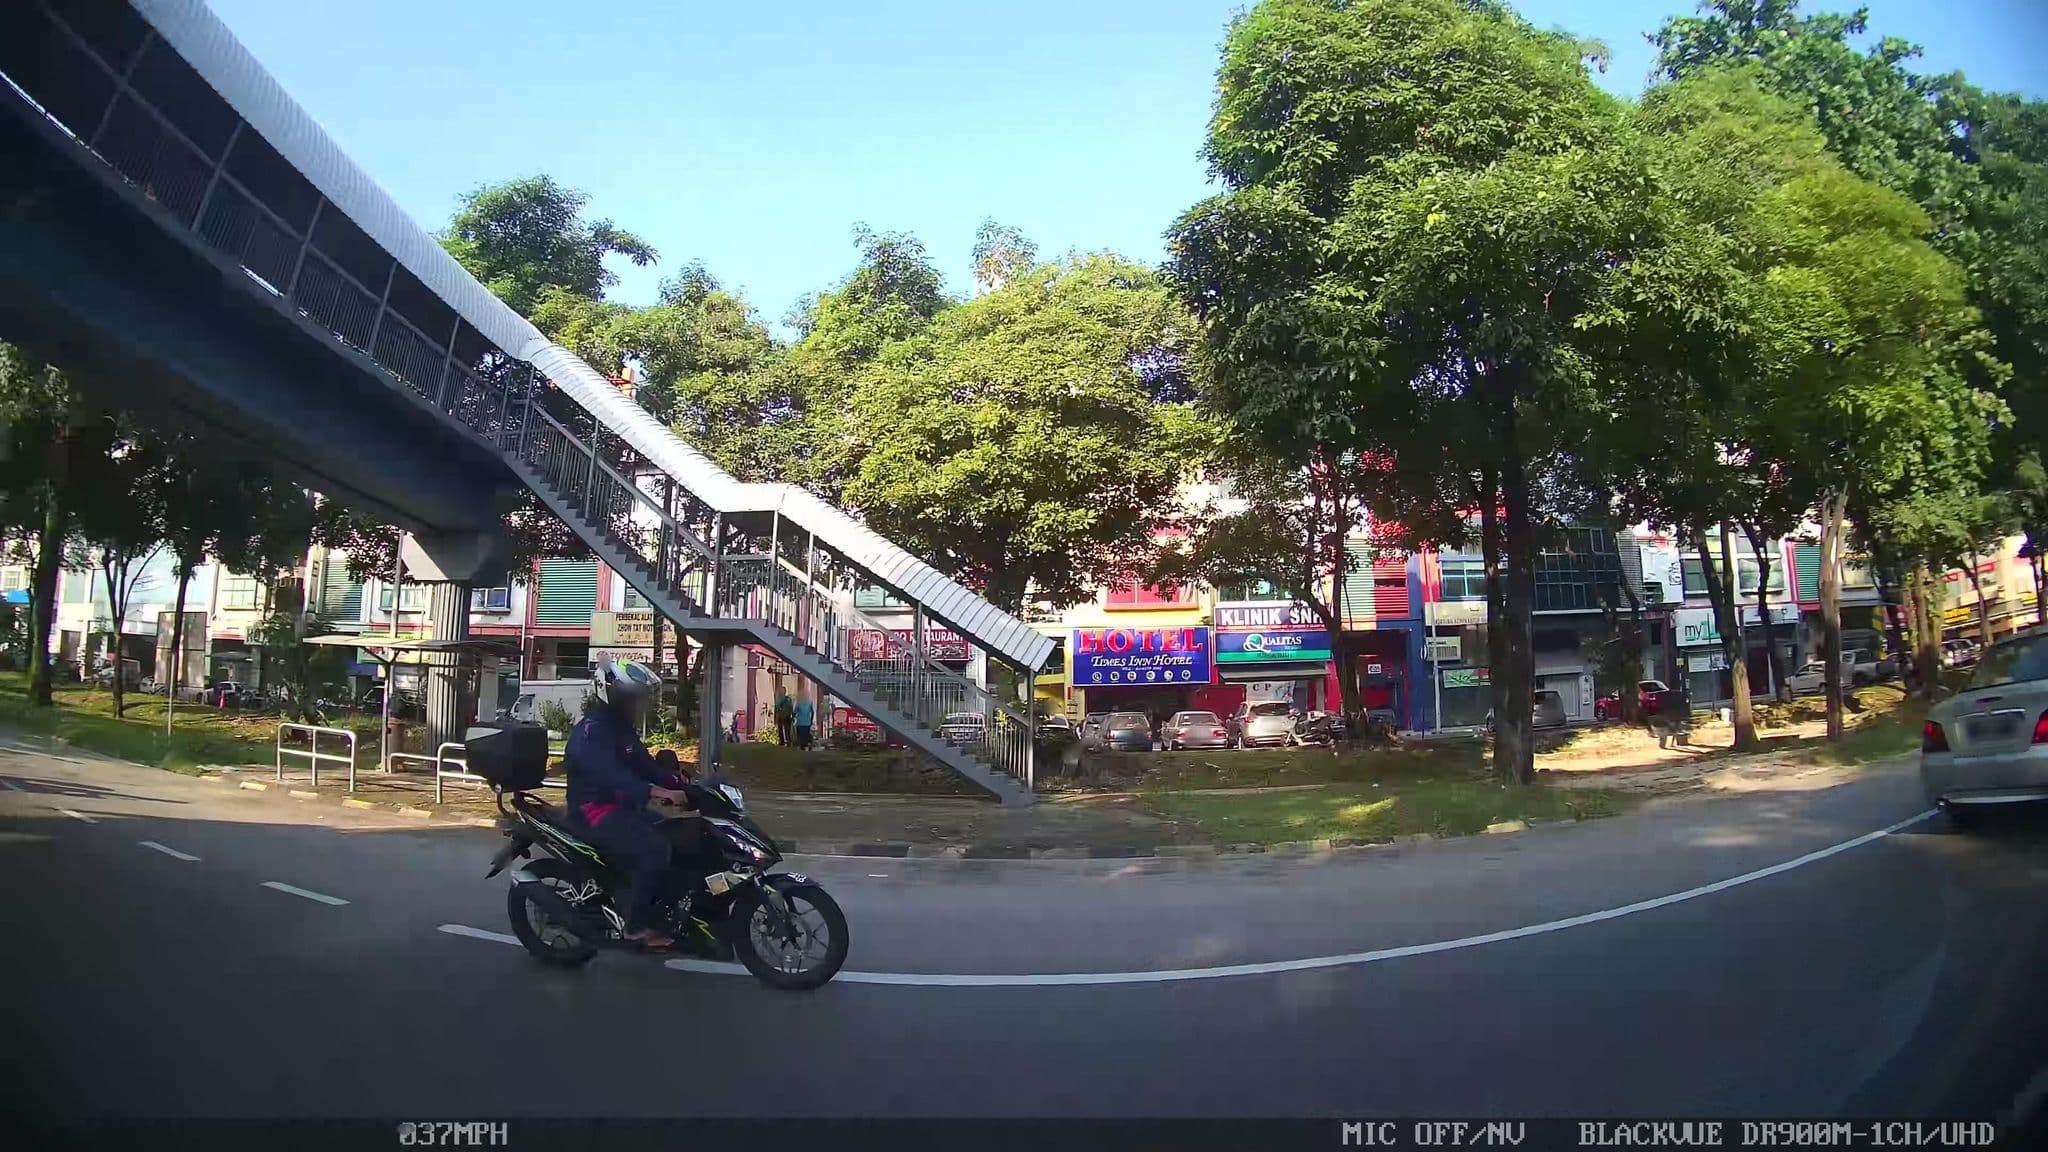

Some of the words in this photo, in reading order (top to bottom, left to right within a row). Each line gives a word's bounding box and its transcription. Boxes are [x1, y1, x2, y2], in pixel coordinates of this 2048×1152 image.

[1221, 608, 1282, 625] KLINIK
[633, 623, 642, 633] TAT
[1079, 627, 1203, 653] HOTEL
[1243, 633, 1302, 654] QUALITAS
[609, 651, 644, 660] TOYOTA
